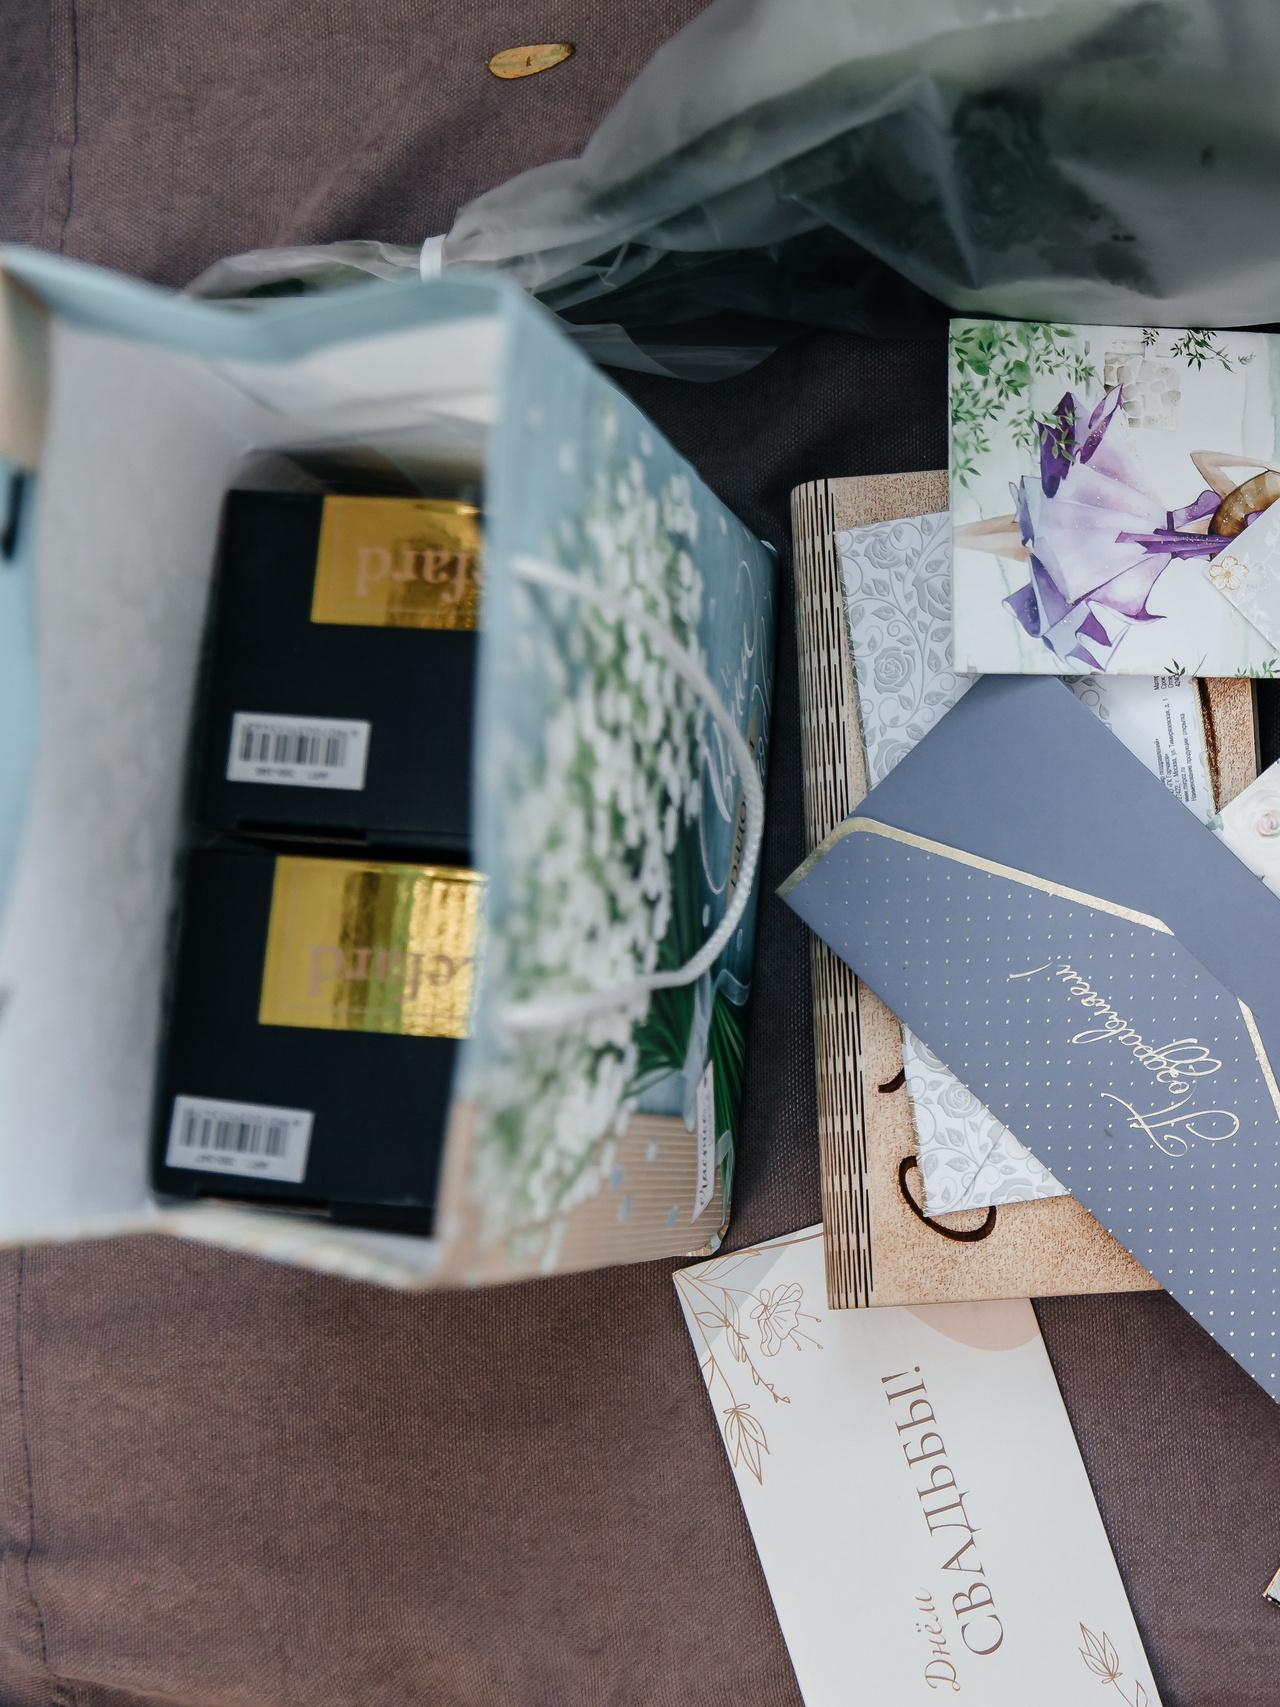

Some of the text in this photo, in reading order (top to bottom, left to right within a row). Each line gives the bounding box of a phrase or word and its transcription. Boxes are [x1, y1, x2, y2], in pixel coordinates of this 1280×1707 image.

[355, 546, 481, 603] fard
[307, 944, 471, 1003] efard
[1009, 962, 1241, 1158] Поздравляем!
[880, 1365, 1005, 1657] СВАДЬБЫ!
